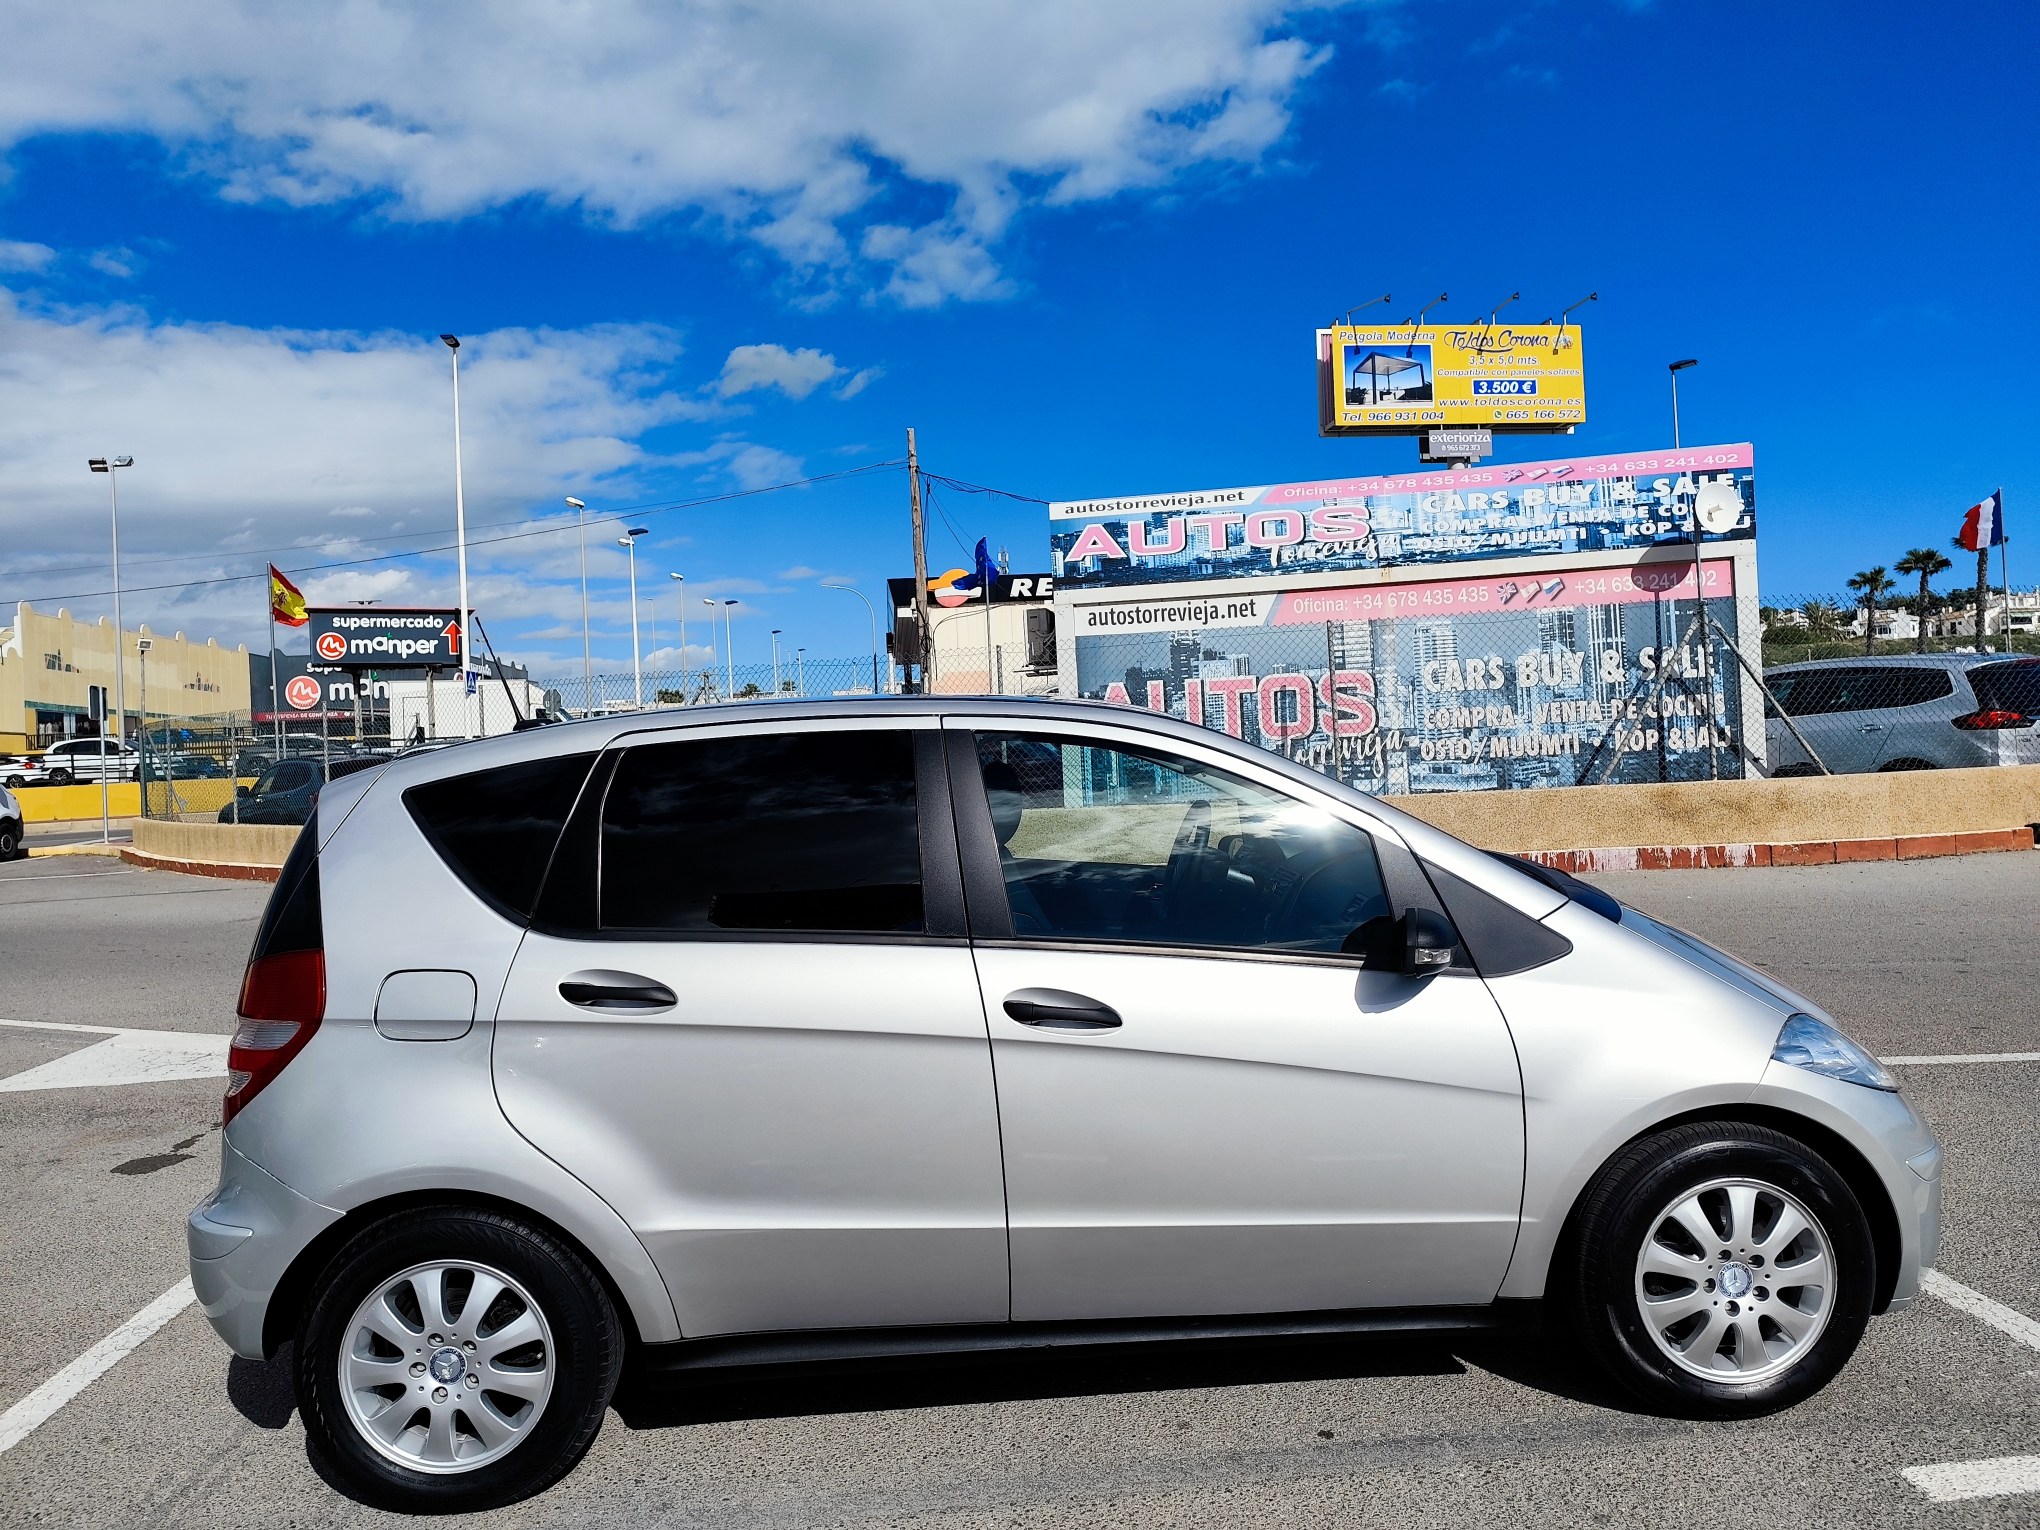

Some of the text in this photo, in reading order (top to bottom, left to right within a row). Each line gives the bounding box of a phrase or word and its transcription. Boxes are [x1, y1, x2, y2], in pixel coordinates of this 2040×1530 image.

[1387, 331, 1435, 340] Moderna
[1444, 330, 1549, 351] Toldos Corona
[1498, 355, 1514, 366] 5,0
[1437, 368, 1489, 377] Compatible
[1510, 368, 1545, 377] paneles
[1548, 368, 1580, 376] solares
[1478, 381, 1533, 394] 3.500 €
[1439, 397, 1581, 407] www.toldoscorona.es
[1342, 411, 1444, 421] Tel. 966 931 004
[1506, 409, 1581, 419] 665 166 572
[1430, 432, 1491, 443] exterioriza
[1585, 453, 1738, 473] +34 633 241 402
[1284, 472, 1493, 498] Oficina: +34 678 435 435
[1065, 490, 1245, 515] autostorrevieja.net
[1422, 490, 1510, 514] CARS
[1524, 483, 1596, 507] BUY
[1612, 481, 1638, 500] &
[1538, 507, 1614, 527] VENTA
[1621, 505, 1649, 519] DE
[1064, 506, 1372, 563] AUTOS
[1625, 519, 1672, 536] KÖP
[1575, 577, 1606, 595] +34
[1612, 575, 1644, 593] 633
[1649, 572, 1680, 590] 241
[1293, 586, 1489, 614] Oficina: +34 678 435 435
[332, 615, 443, 631] supermercado
[1087, 598, 1256, 627] autostorrevieja.net
[350, 634, 439, 659] manper
[1423, 656, 1505, 692] CARS
[1518, 650, 1585, 688] BUY
[1600, 649, 1626, 683] &
[1425, 704, 1515, 730] COMPRA
[1537, 699, 1603, 725] VENTA
[1611, 697, 1638, 720] DE
